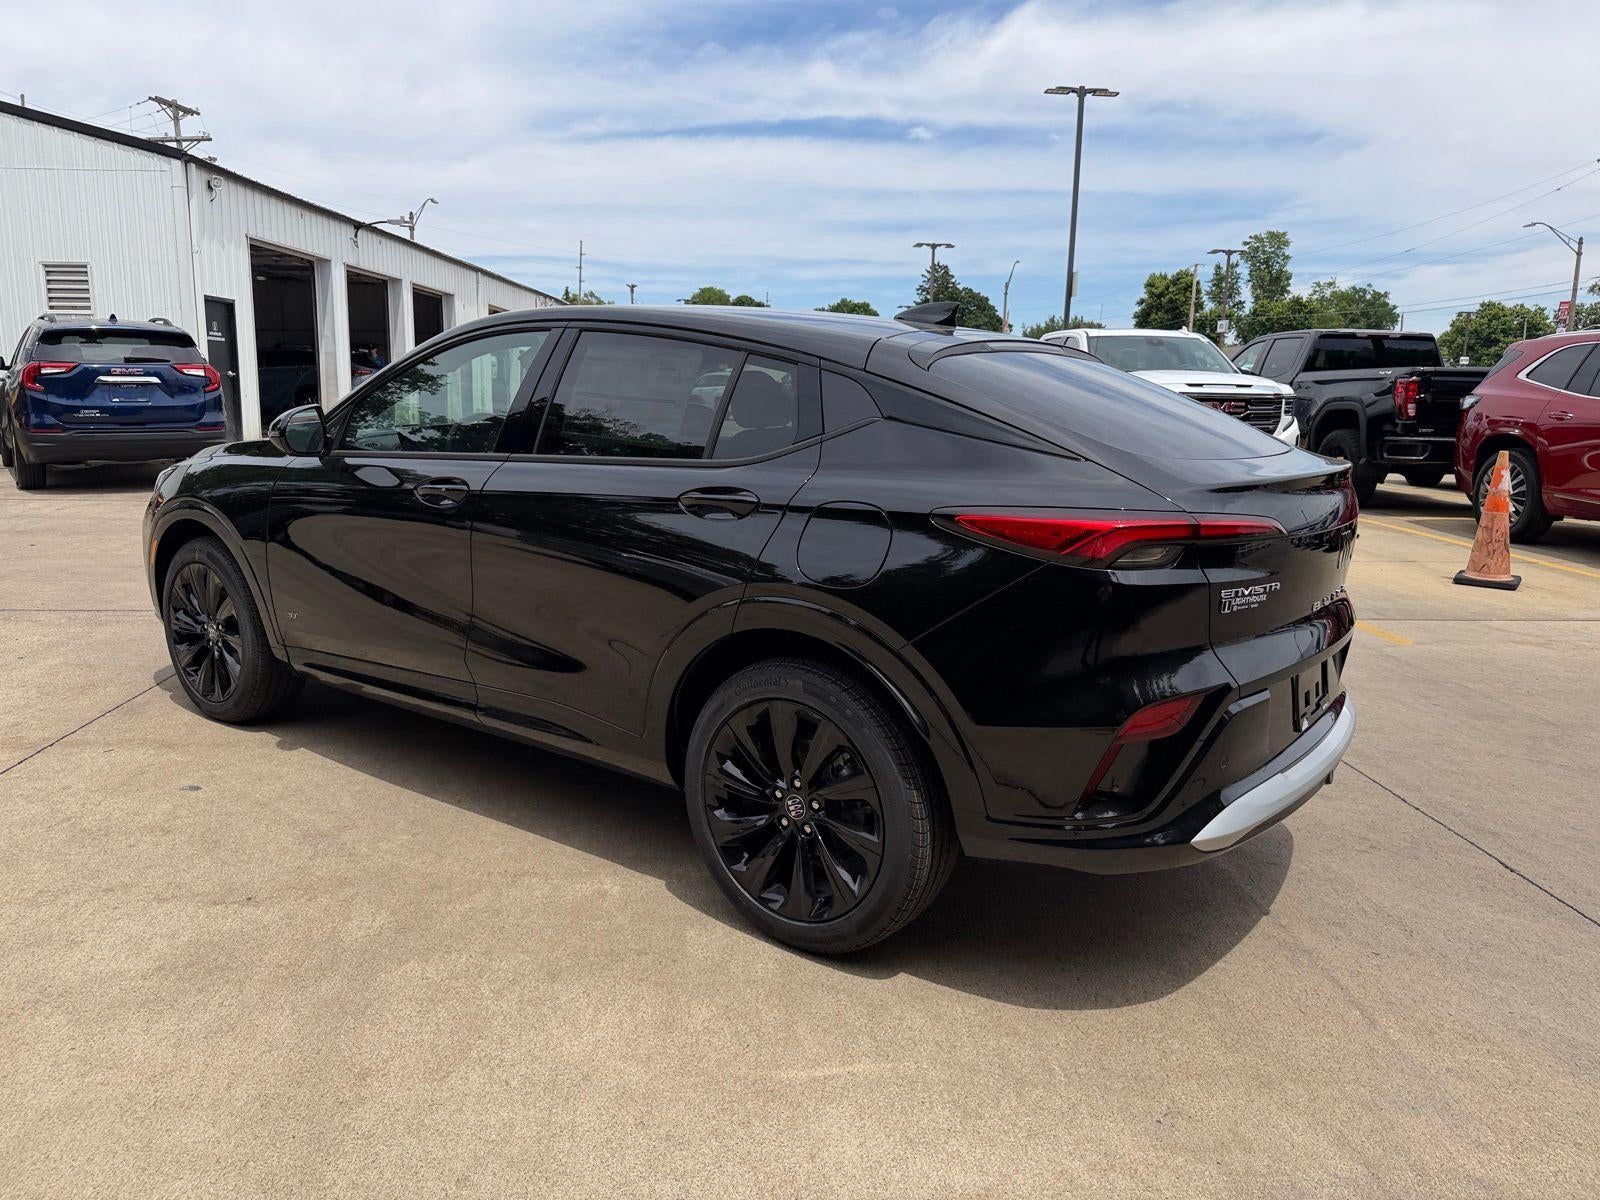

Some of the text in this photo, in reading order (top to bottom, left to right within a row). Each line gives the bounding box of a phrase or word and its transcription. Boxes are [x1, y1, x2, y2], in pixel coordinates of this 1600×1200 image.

[110, 367, 144, 375] GMC
[1220, 582, 1281, 599] ENVISTA
[1232, 594, 1267, 605] LIGHTHOUSE
